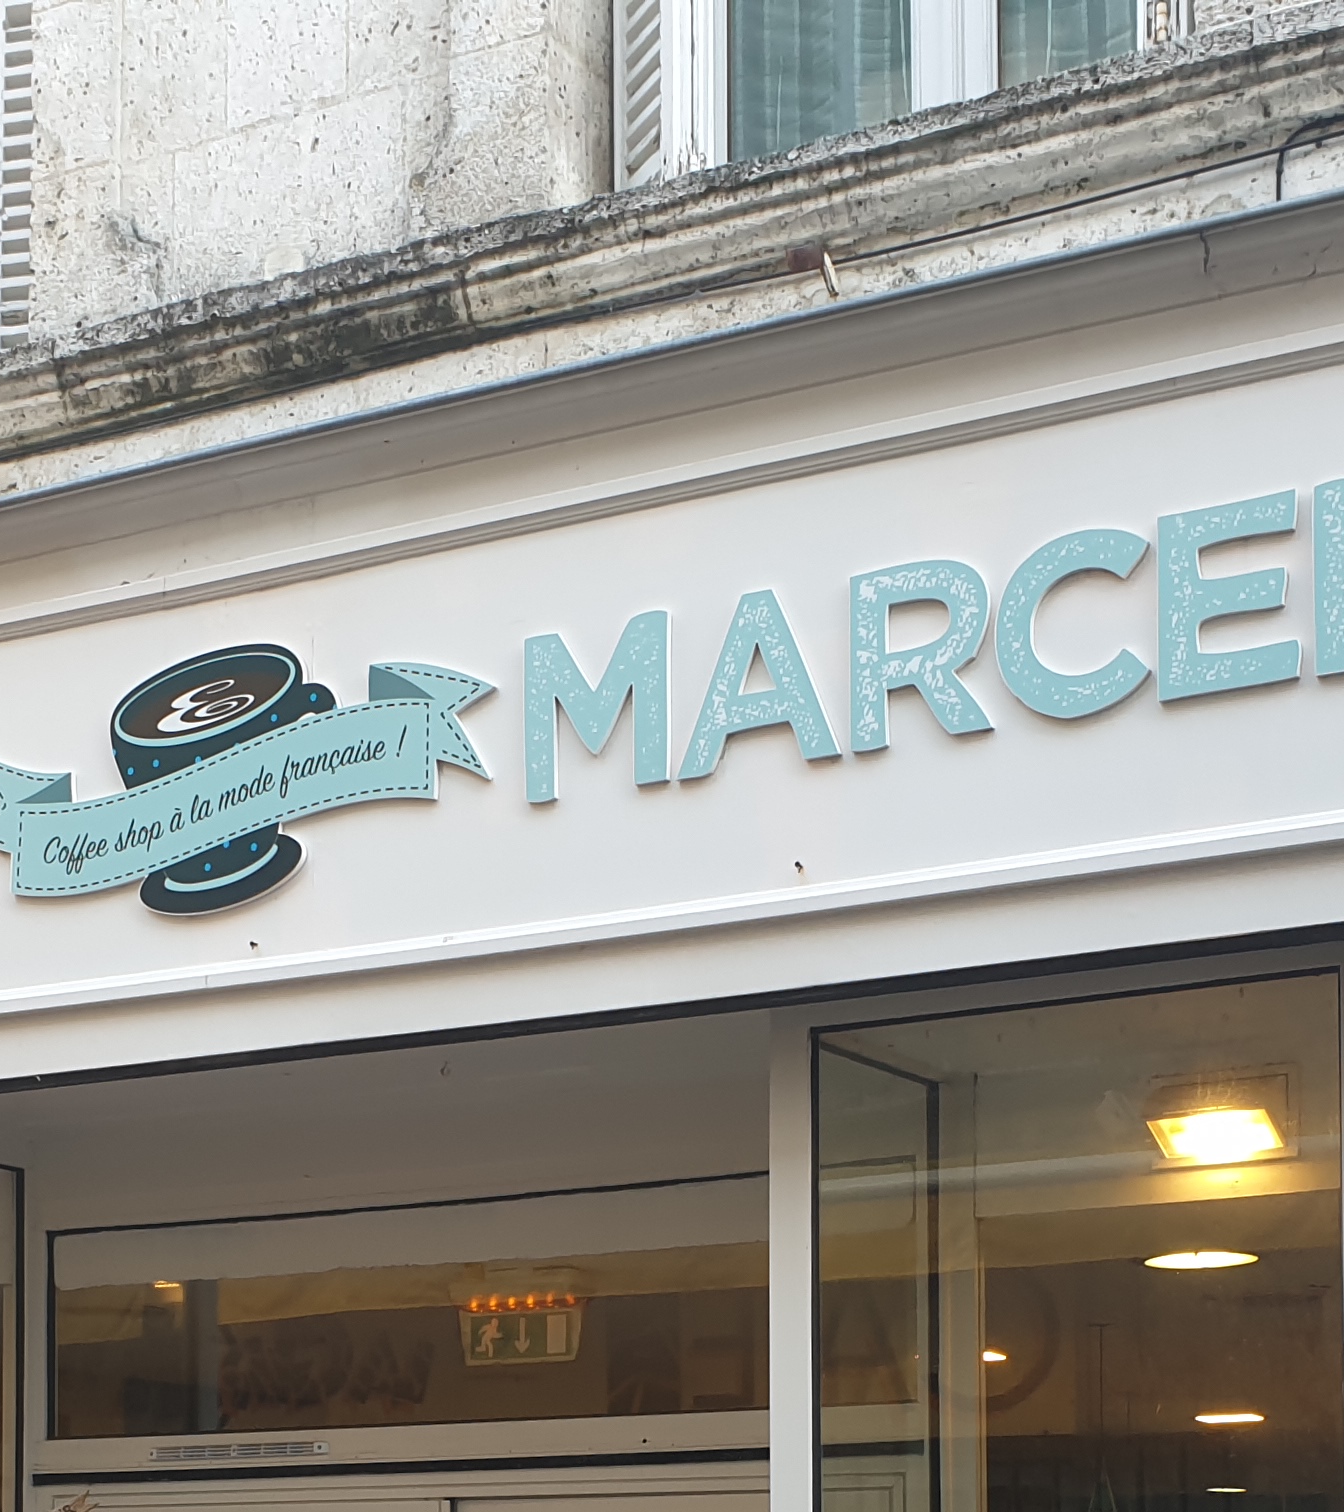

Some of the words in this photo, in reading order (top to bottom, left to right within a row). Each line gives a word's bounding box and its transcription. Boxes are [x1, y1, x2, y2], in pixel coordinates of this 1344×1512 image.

[43, 835, 108, 875] Coffee
[114, 815, 164, 852] shop
[169, 808, 185, 831] à
[190, 794, 213, 823] la
[218, 773, 275, 808] mode
[279, 742, 387, 798] française
